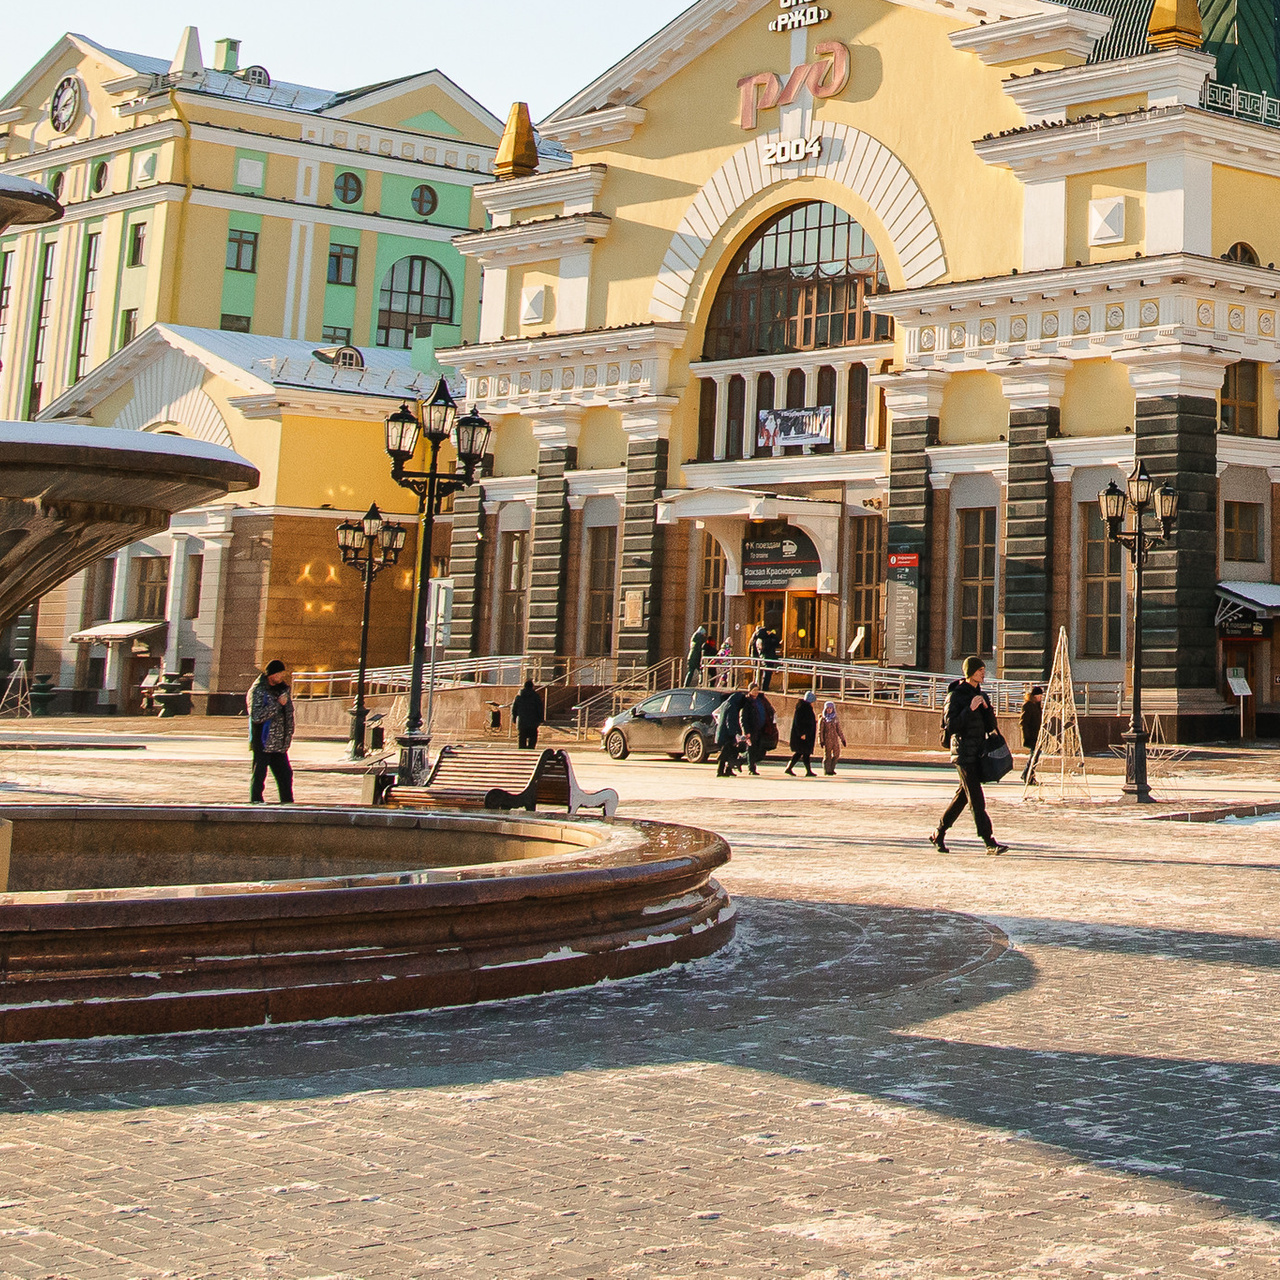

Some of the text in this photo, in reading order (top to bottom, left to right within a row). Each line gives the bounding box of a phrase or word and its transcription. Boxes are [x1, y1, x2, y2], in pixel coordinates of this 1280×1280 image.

[768, 6, 830, 32] «РЖД»
[762, 136, 822, 166] 2004
[744, 567, 802, 577] Вокзал Красноярск
